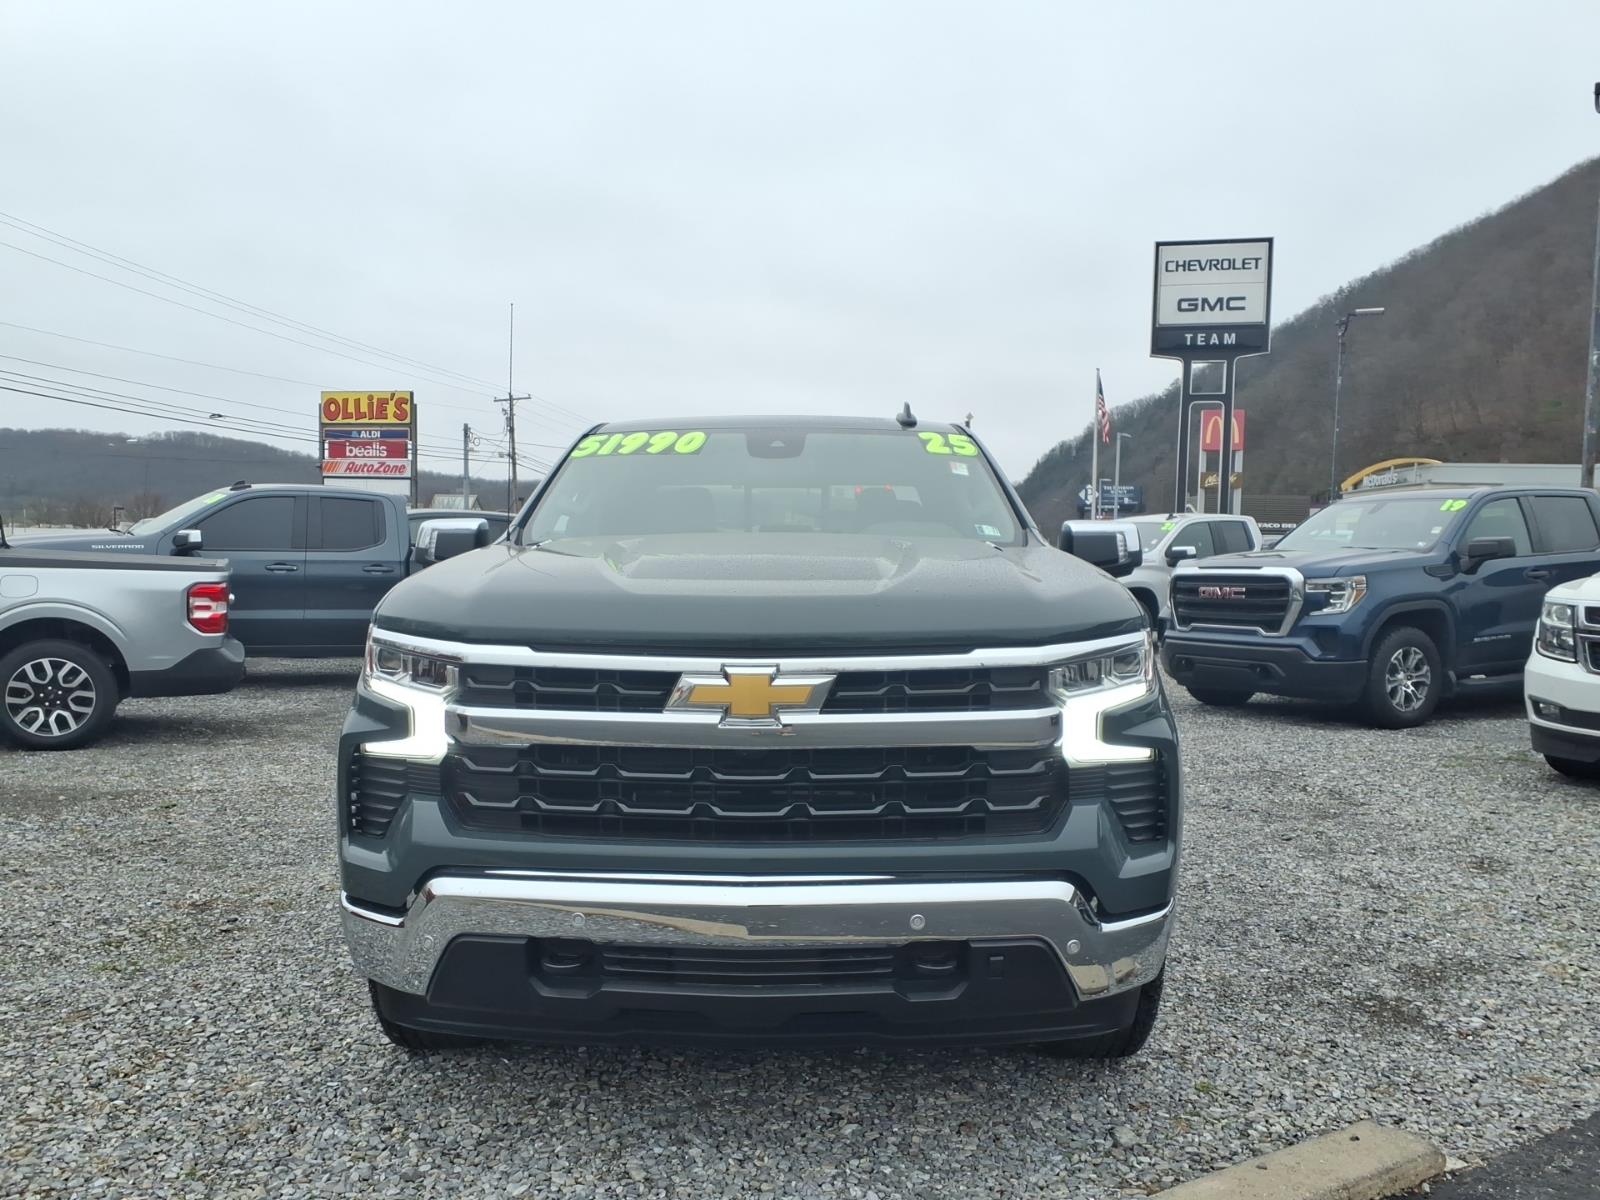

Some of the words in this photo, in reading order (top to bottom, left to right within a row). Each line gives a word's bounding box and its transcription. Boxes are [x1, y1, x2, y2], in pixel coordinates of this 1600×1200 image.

[1165, 257, 1262, 273] CHEVROLET
[1177, 296, 1246, 312] GMC
[1185, 332, 1236, 345] TEAM
[360, 430, 381, 438] ALDI
[345, 441, 388, 457] bealls
[570, 431, 707, 459] 51990
[918, 431, 979, 456] 25
[344, 461, 407, 475] AutoZone
[1440, 499, 1468, 512] 19
[1199, 586, 1246, 599] GMC
